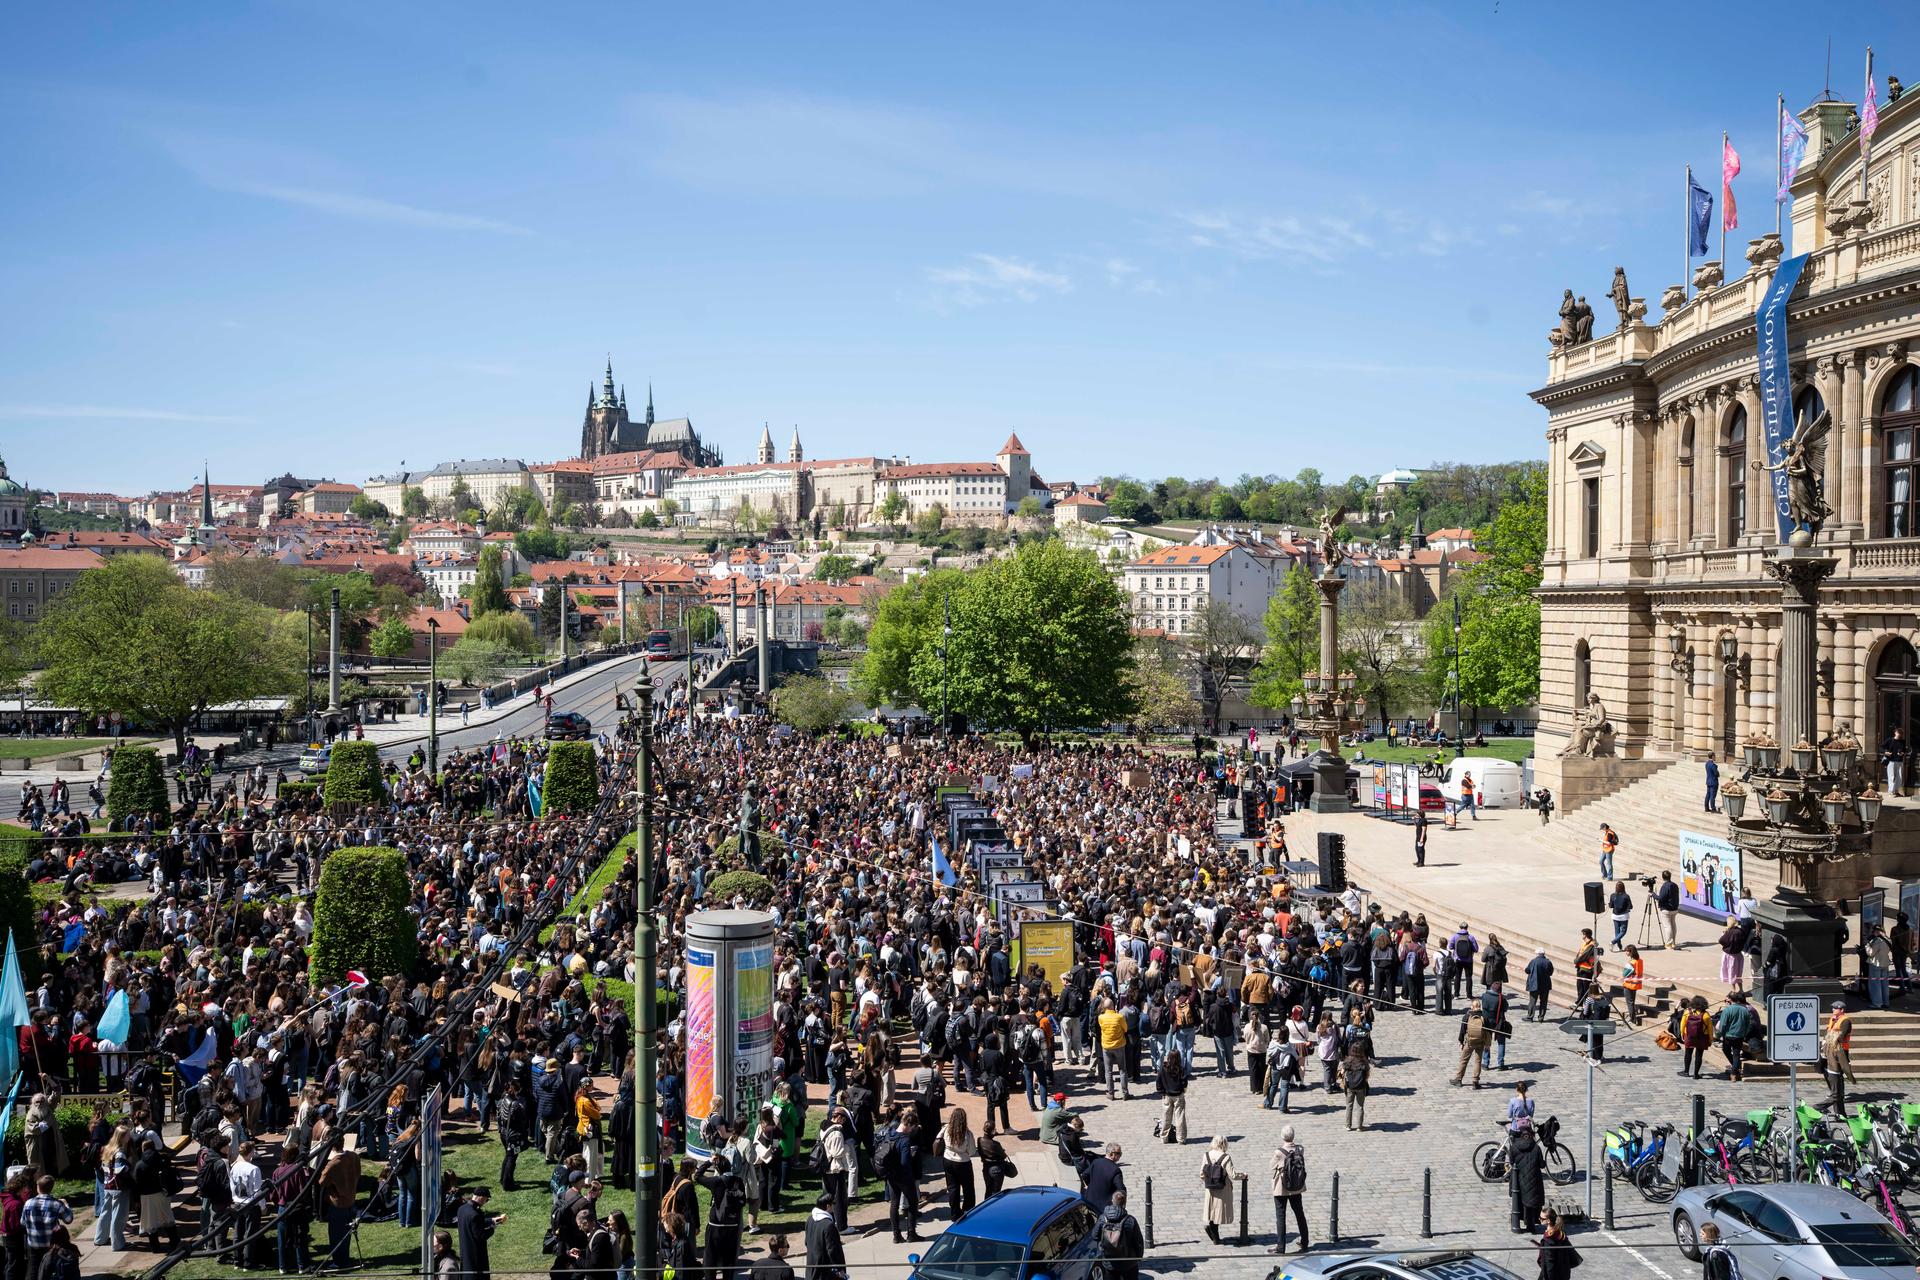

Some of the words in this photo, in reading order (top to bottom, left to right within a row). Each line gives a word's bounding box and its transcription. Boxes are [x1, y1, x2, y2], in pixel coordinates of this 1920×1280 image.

[1765, 283, 1789, 439] FILHARMONIE
[1795, 1001, 1814, 1009] ZÓNA
[64, 1097, 120, 1109] PARKG
[1427, 1260, 1490, 1280] A51
